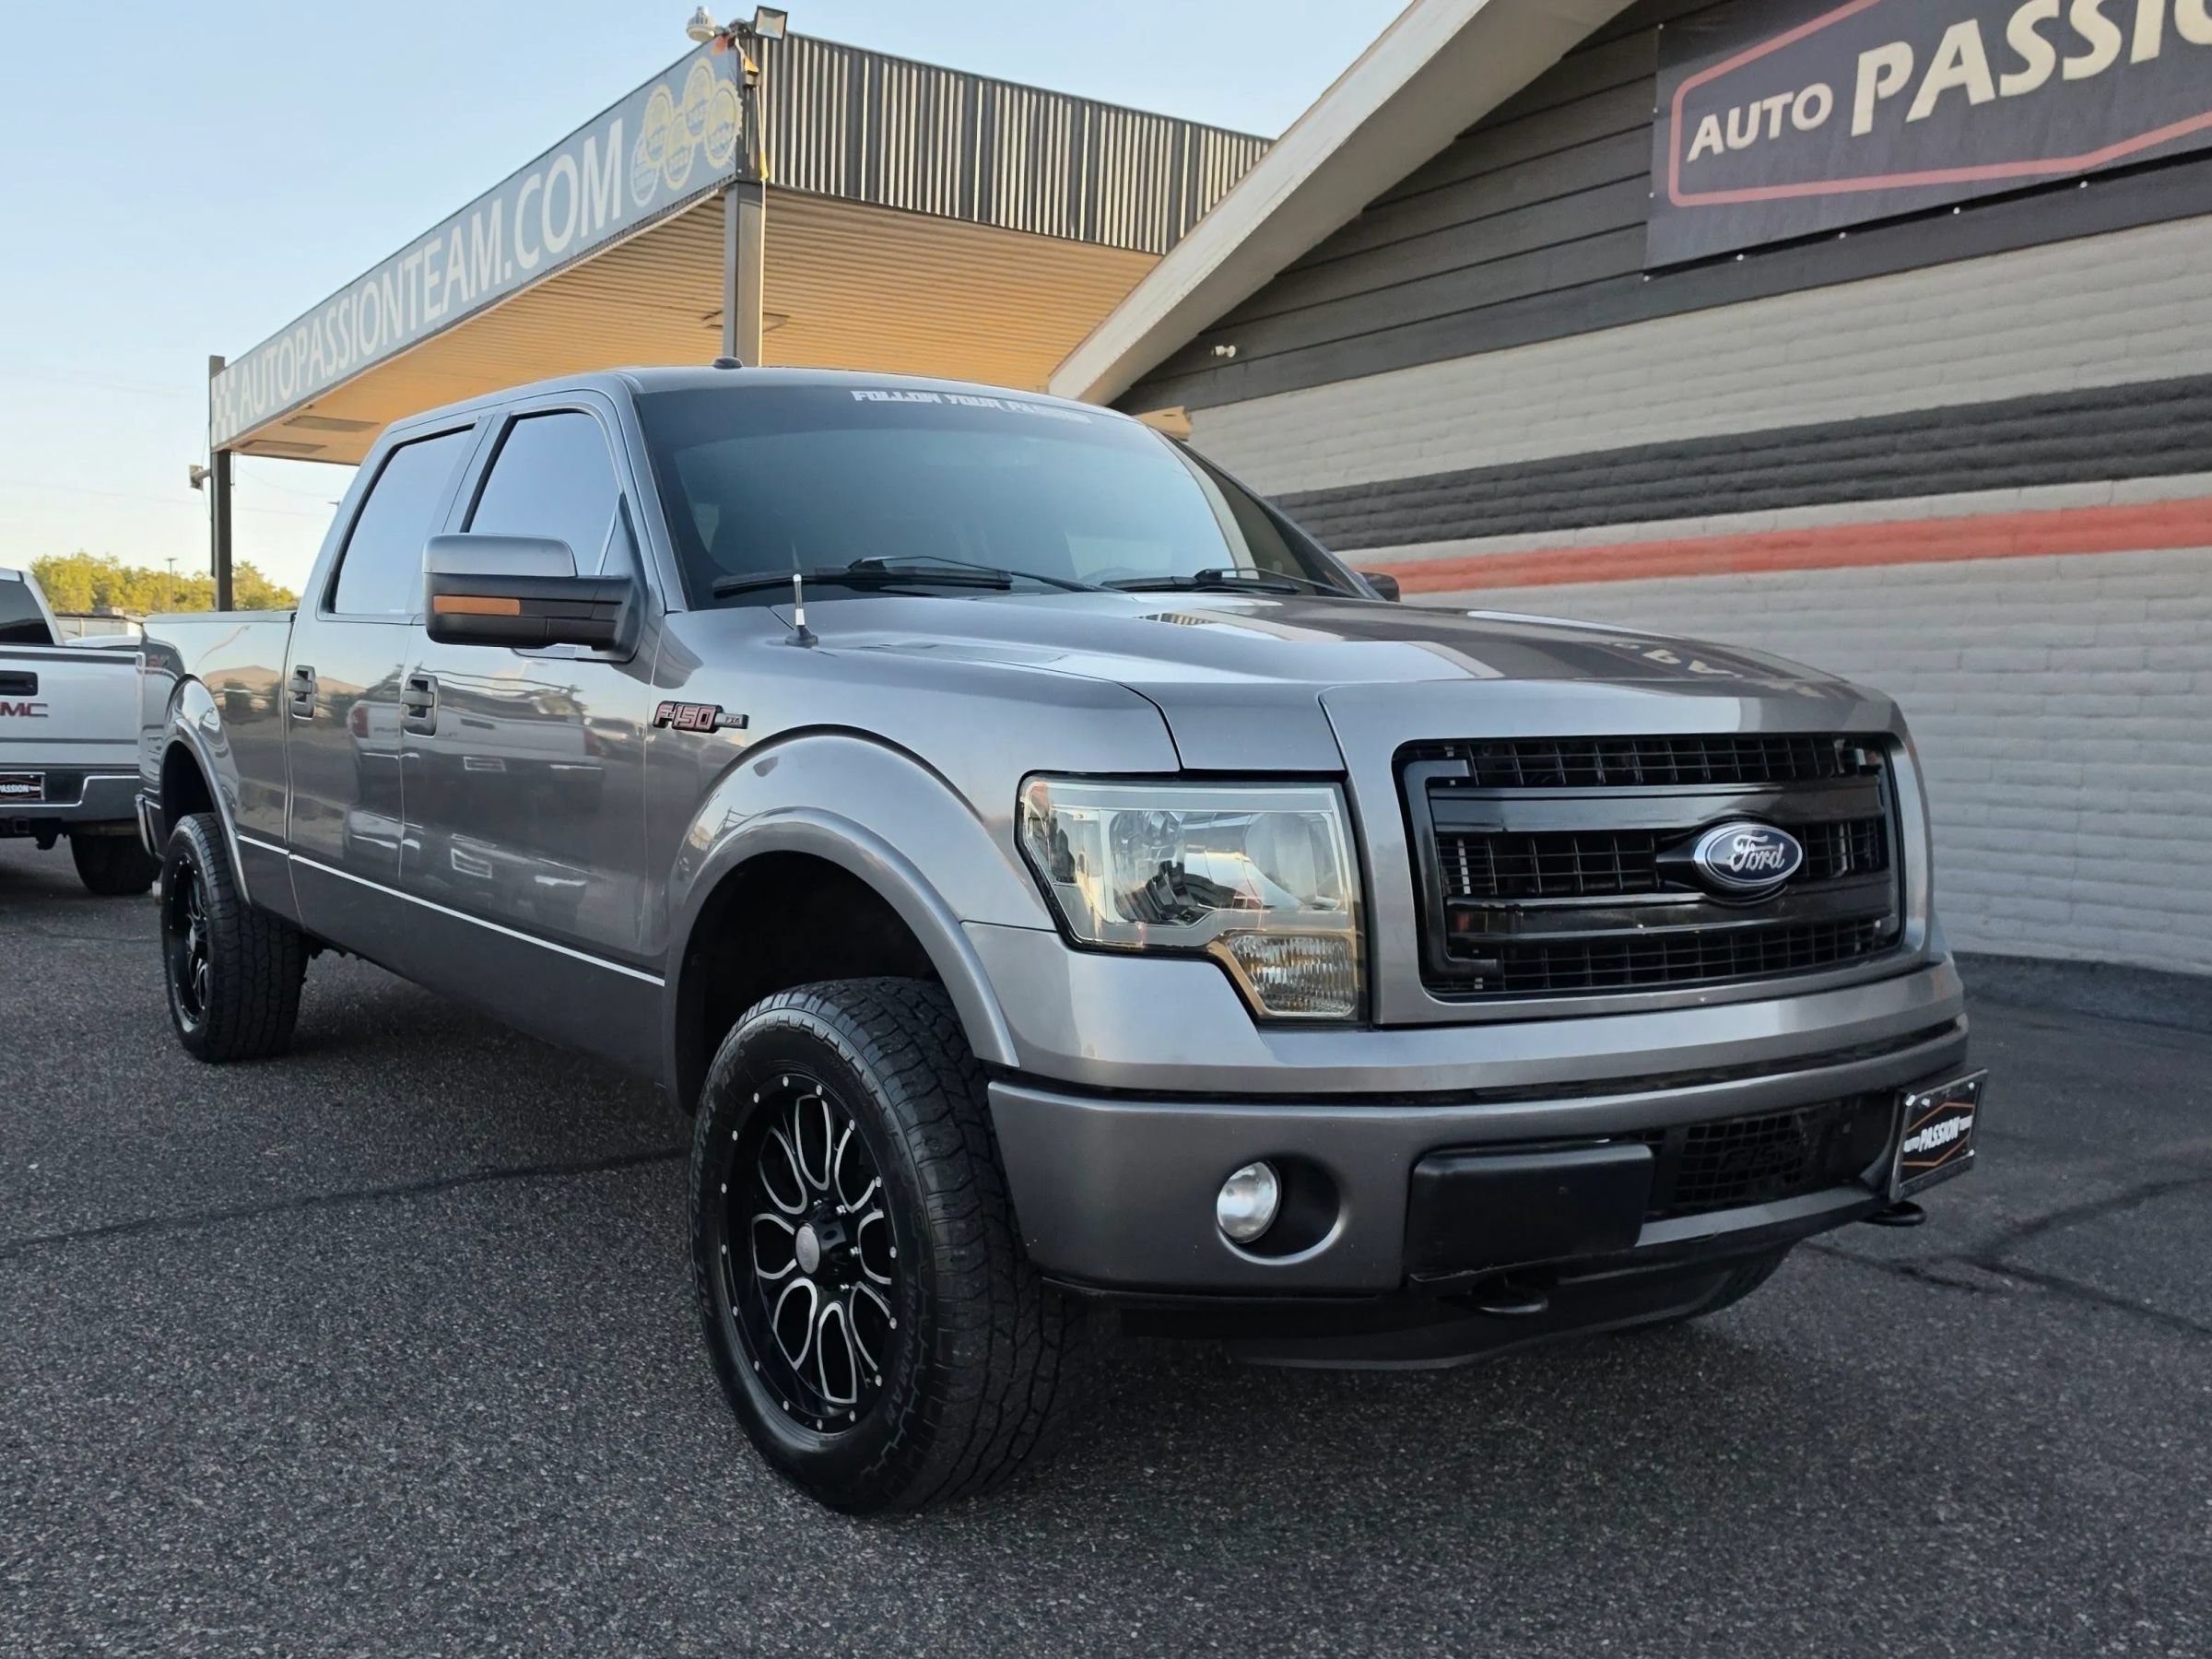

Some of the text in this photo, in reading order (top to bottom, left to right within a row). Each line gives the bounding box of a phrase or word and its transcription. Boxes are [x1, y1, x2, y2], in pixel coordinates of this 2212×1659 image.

[1687, 0, 2212, 162] AUTO PASSI
[239, 118, 623, 425] AUTOPASSIONTEAM.COM
[850, 390, 942, 404] FOLLOW
[943, 394, 1006, 412] YOUR
[0, 701, 49, 718] MC
[653, 701, 720, 732] F-150
[0, 784, 29, 793] ASSION
[1727, 834, 1785, 873] Ford
[1918, 1115, 1960, 1153] PASSION
